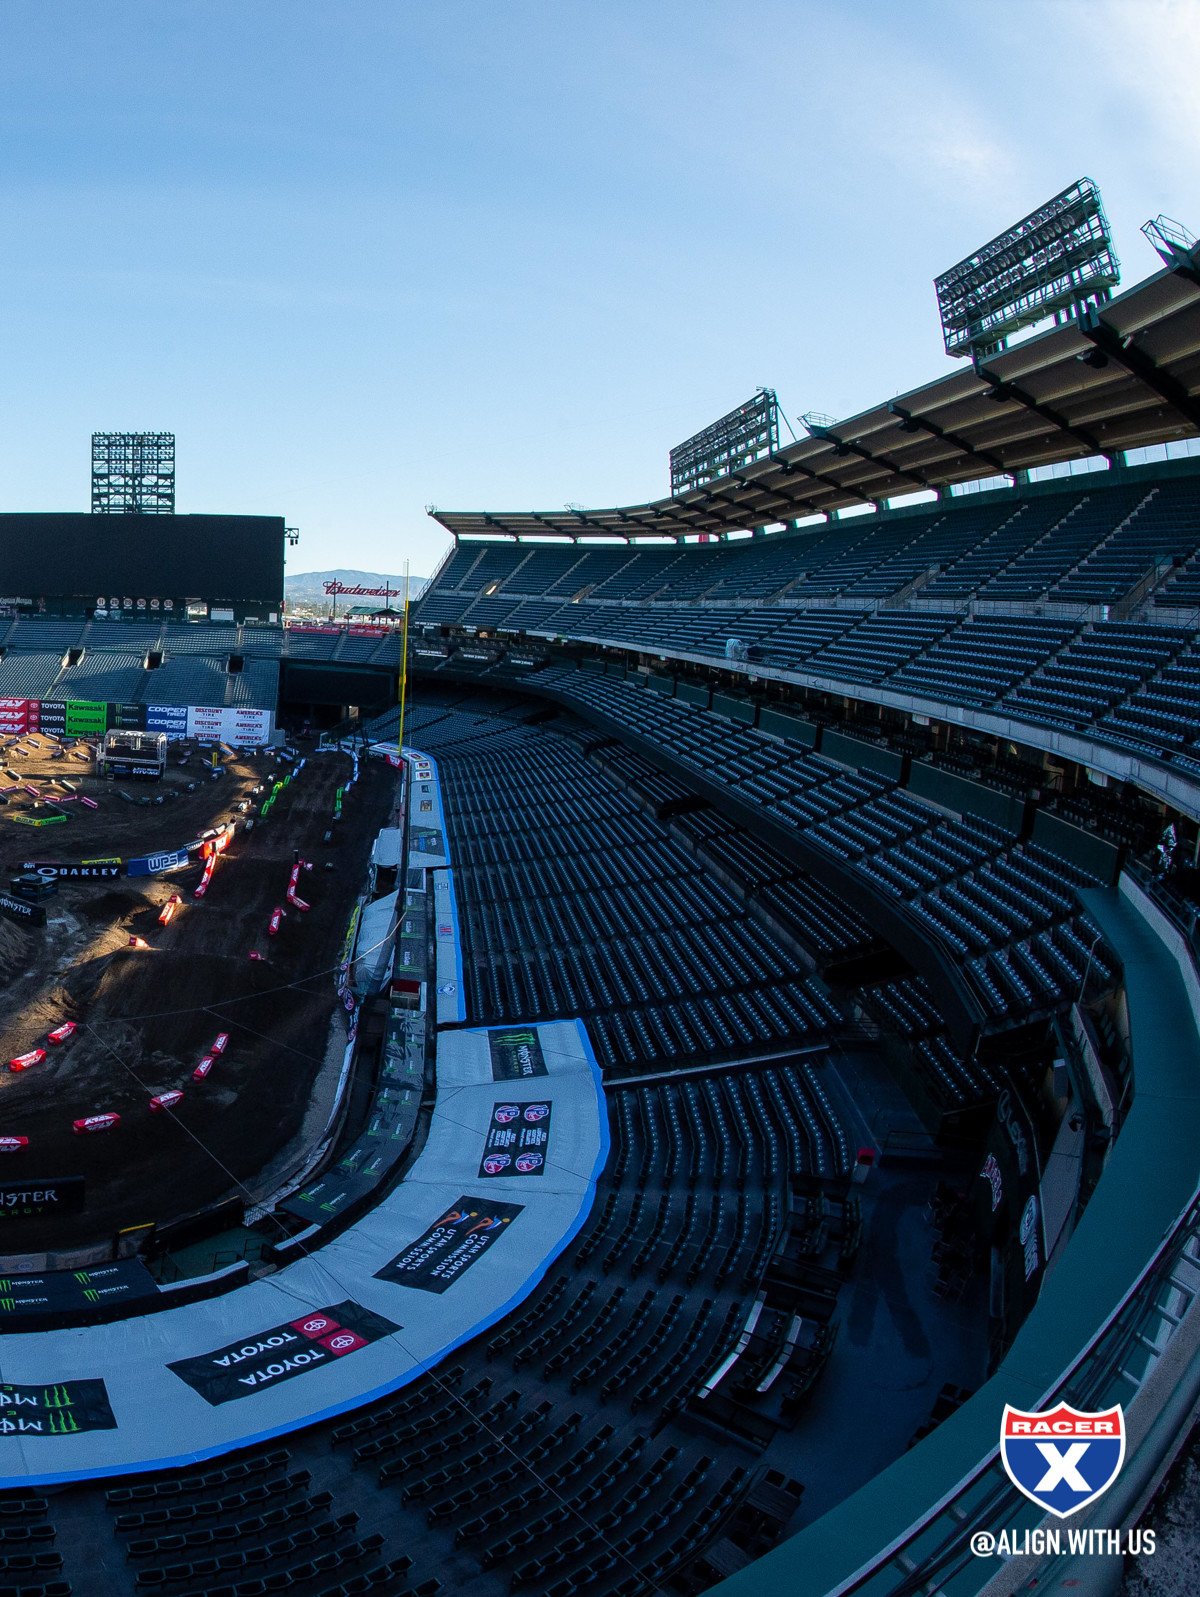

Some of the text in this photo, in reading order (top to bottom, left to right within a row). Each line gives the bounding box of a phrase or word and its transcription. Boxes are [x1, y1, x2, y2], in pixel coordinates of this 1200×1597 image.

[322, 581, 400, 597] Budweiser
[60, 868, 118, 876] OAKLEY
[148, 854, 179, 872] WPS
[517, 1045, 533, 1076] MONSTER
[407, 1228, 457, 1271] UTAH SPORTS
[430, 1233, 478, 1277] COMMISSION
[441, 1235, 490, 1279] UTAH SPORTS
[88, 1267, 119, 1278] MONSTER
[98, 1285, 130, 1294] MONSTER
[212, 1332, 298, 1367] TOYOTA
[238, 1349, 326, 1386] TOYOTA
